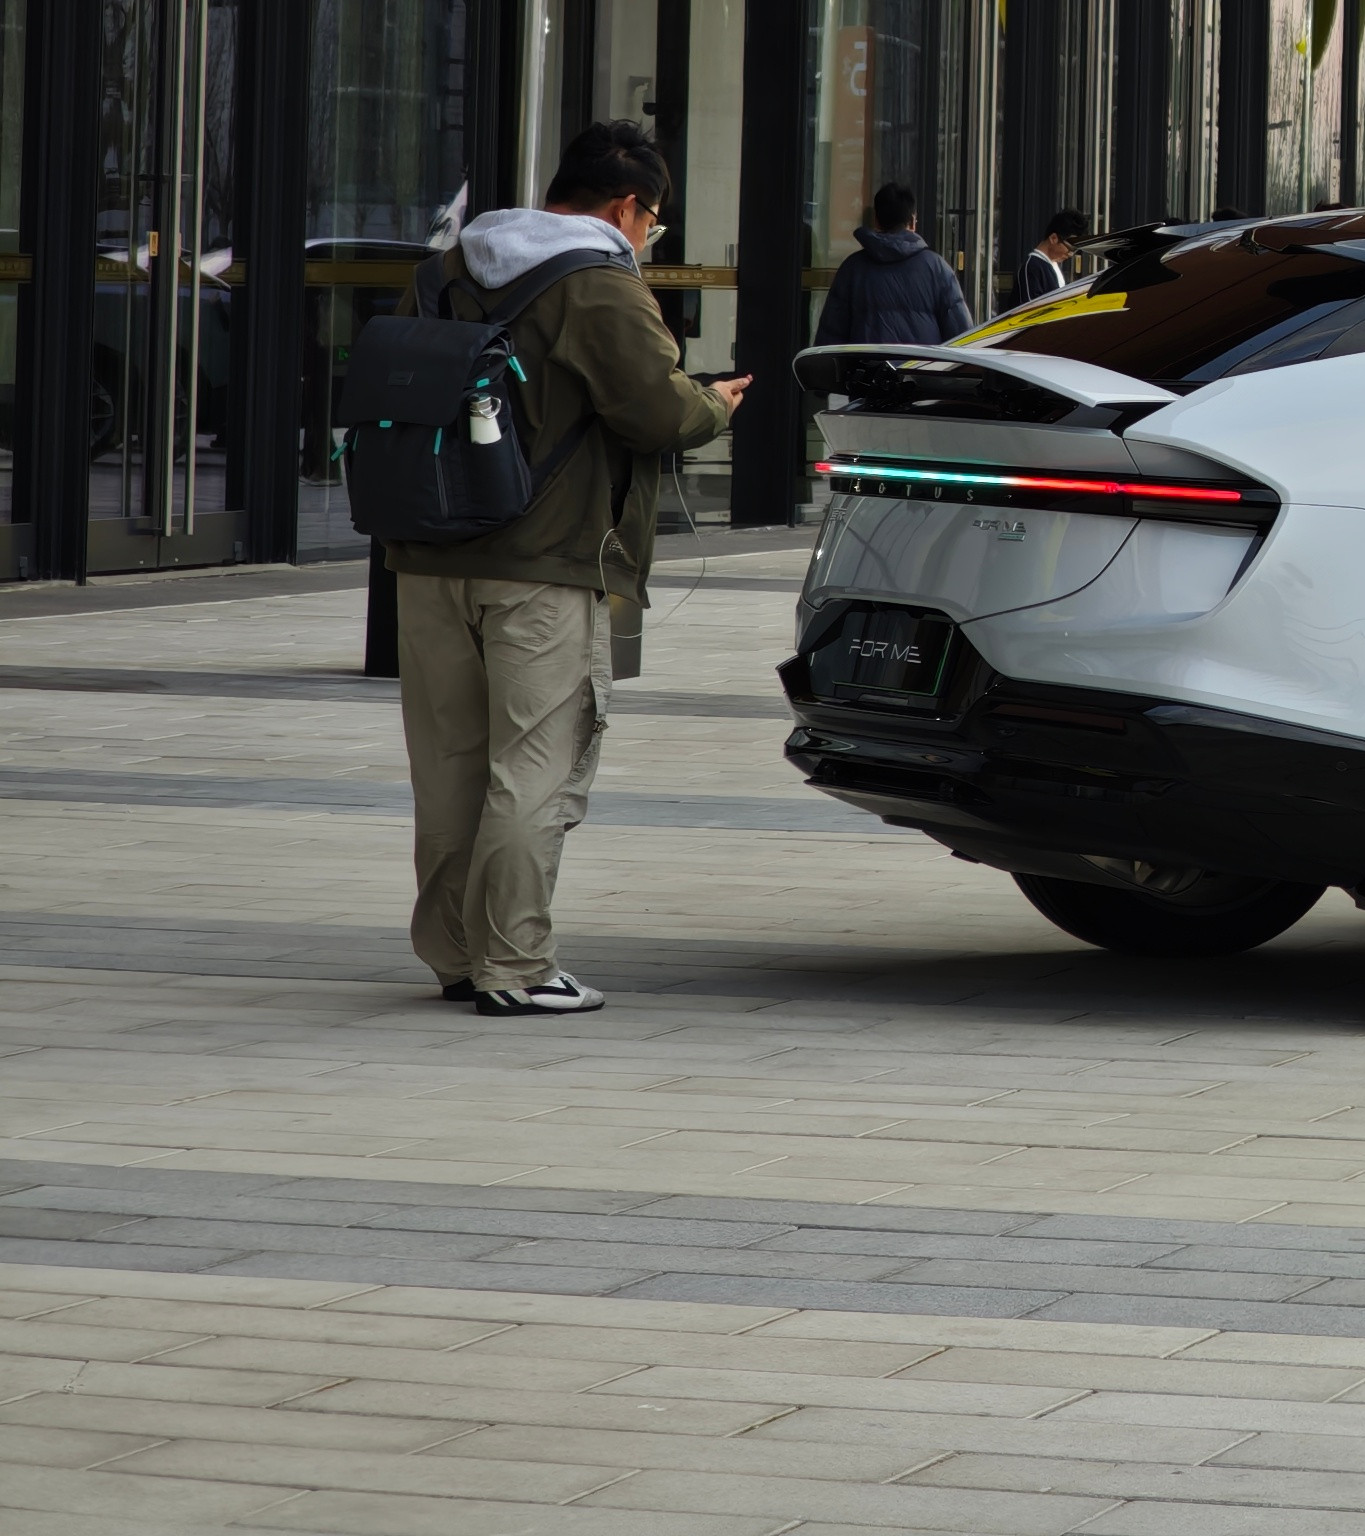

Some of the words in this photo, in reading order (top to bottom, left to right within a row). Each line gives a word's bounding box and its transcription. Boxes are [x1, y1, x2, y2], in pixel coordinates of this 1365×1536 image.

[854, 479, 974, 502] LOTUS
[848, 638, 889, 659] FOR
[890, 643, 922, 664] ME
